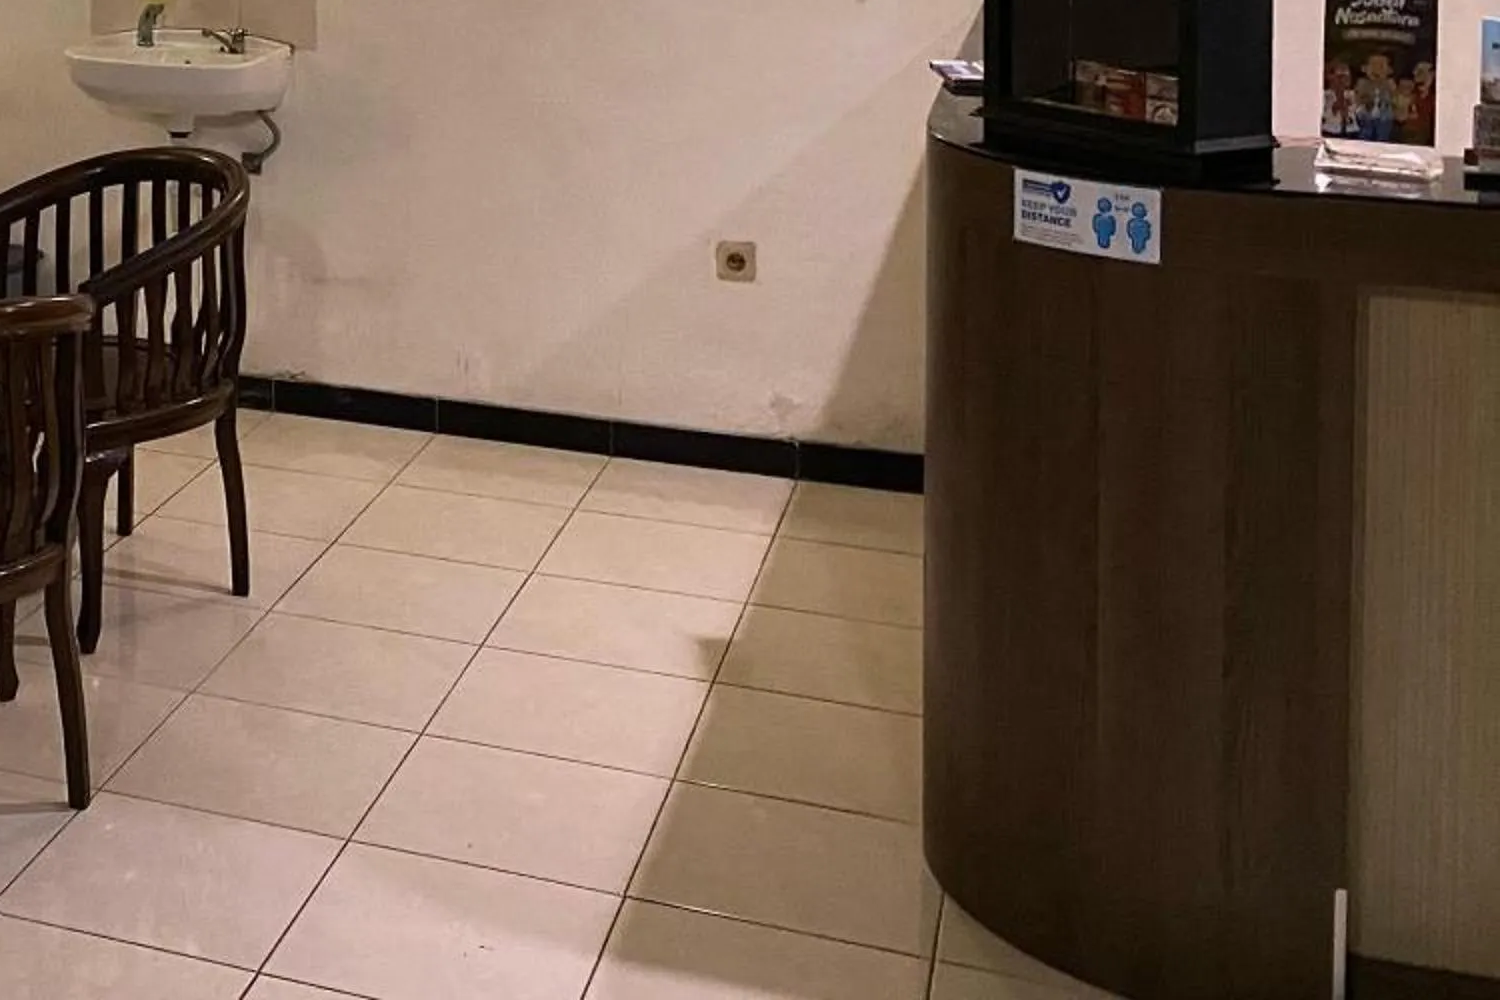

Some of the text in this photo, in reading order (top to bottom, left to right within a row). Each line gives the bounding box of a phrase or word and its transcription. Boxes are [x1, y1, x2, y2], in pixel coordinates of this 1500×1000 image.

[1334, 7, 1421, 28] Nusantara
[1021, 199, 1047, 211] KEEP
[1021, 209, 1072, 228] DISTANCE
